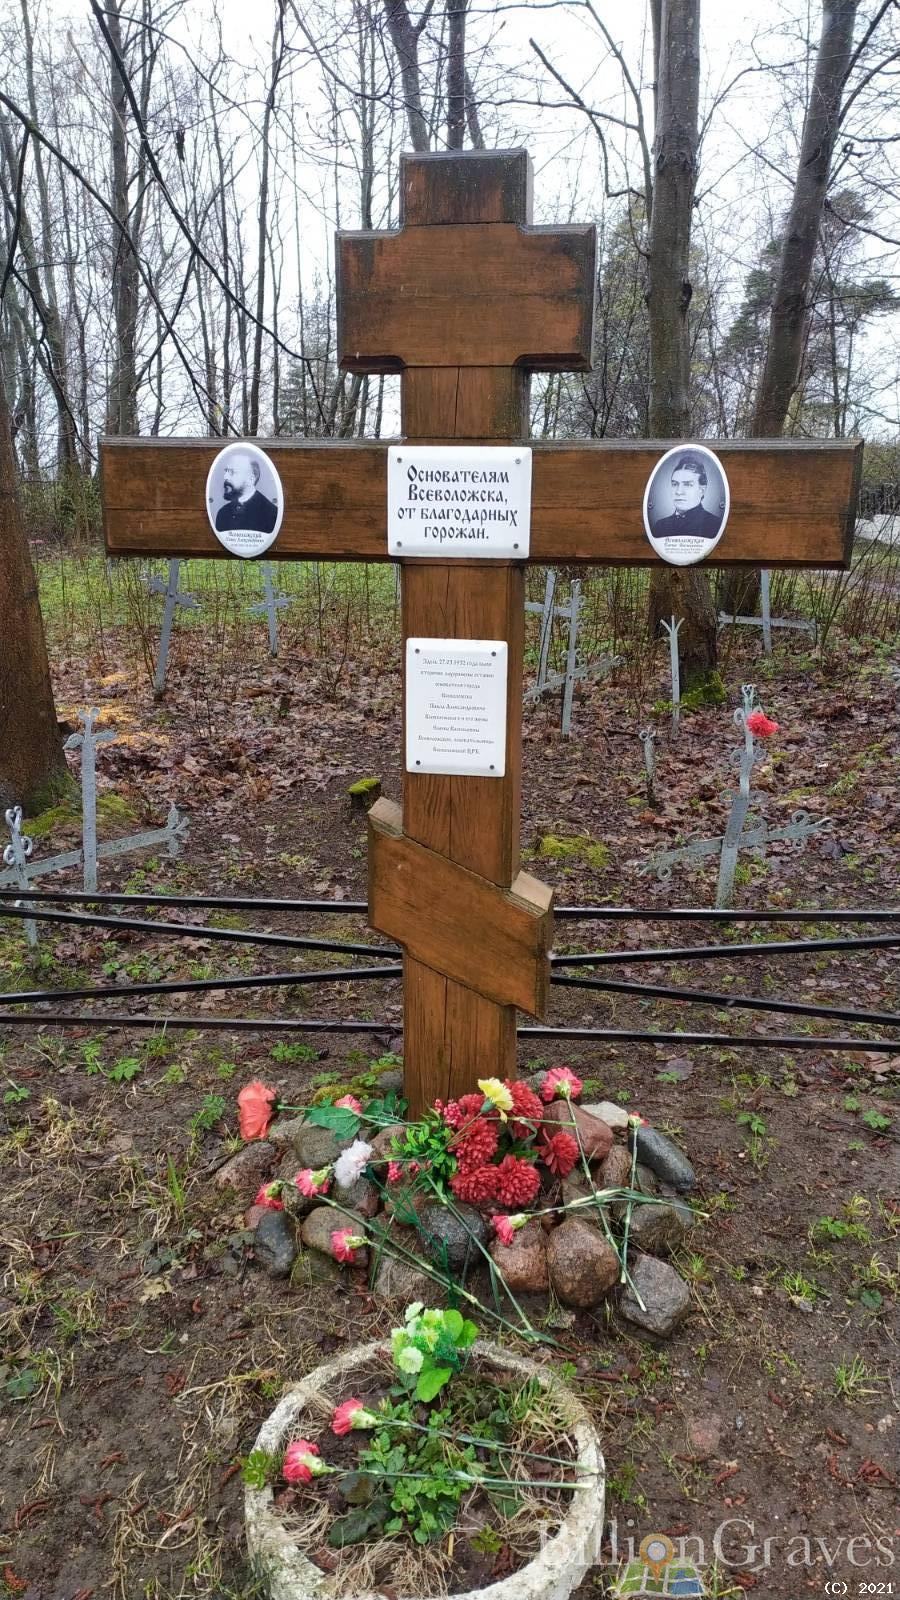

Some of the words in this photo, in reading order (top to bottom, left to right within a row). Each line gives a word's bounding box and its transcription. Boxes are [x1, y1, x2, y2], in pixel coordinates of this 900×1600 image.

[407, 465, 509, 483] Основателям
[408, 483, 508, 504] Всеволожска,
[397, 507, 416, 519] от
[420, 508, 518, 527] благодарных
[424, 526, 489, 543] горожан.
